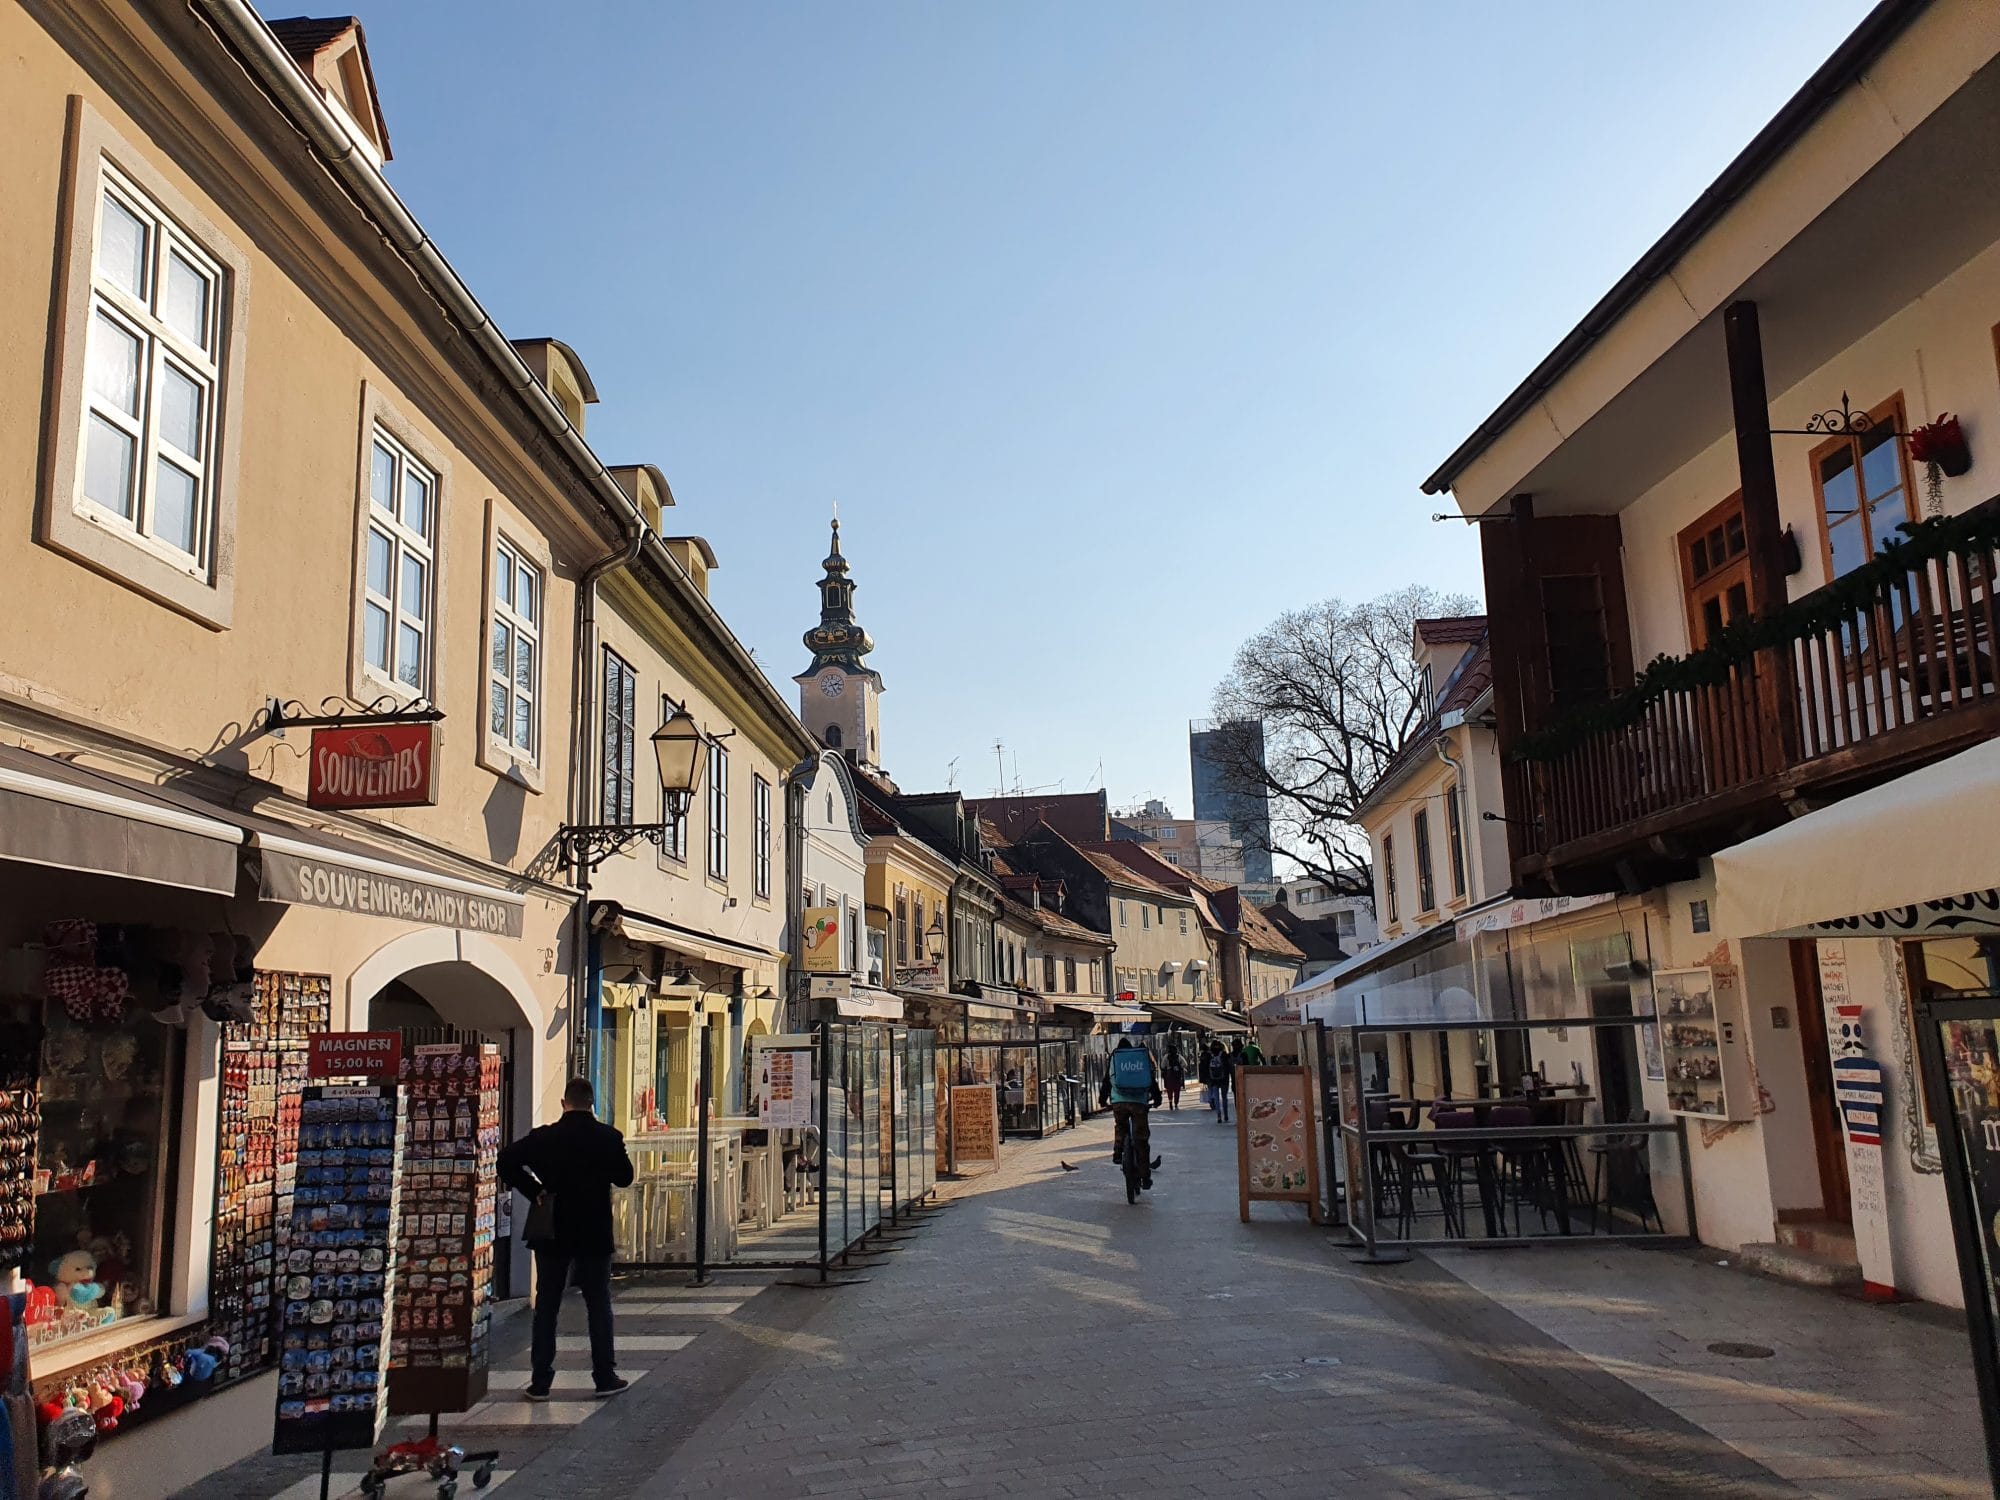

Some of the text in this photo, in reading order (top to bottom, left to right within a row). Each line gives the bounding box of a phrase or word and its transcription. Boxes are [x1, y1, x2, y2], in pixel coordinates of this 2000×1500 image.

[317, 740, 423, 797] SOUVENIRS
[468, 899, 506, 931] SHOP
[318, 1038, 392, 1052] MAGNETI
[325, 1056, 384, 1070] 15,00 kn
[1120, 1061, 1144, 1071] Wolt
[349, 1088, 371, 1096] Gratis
